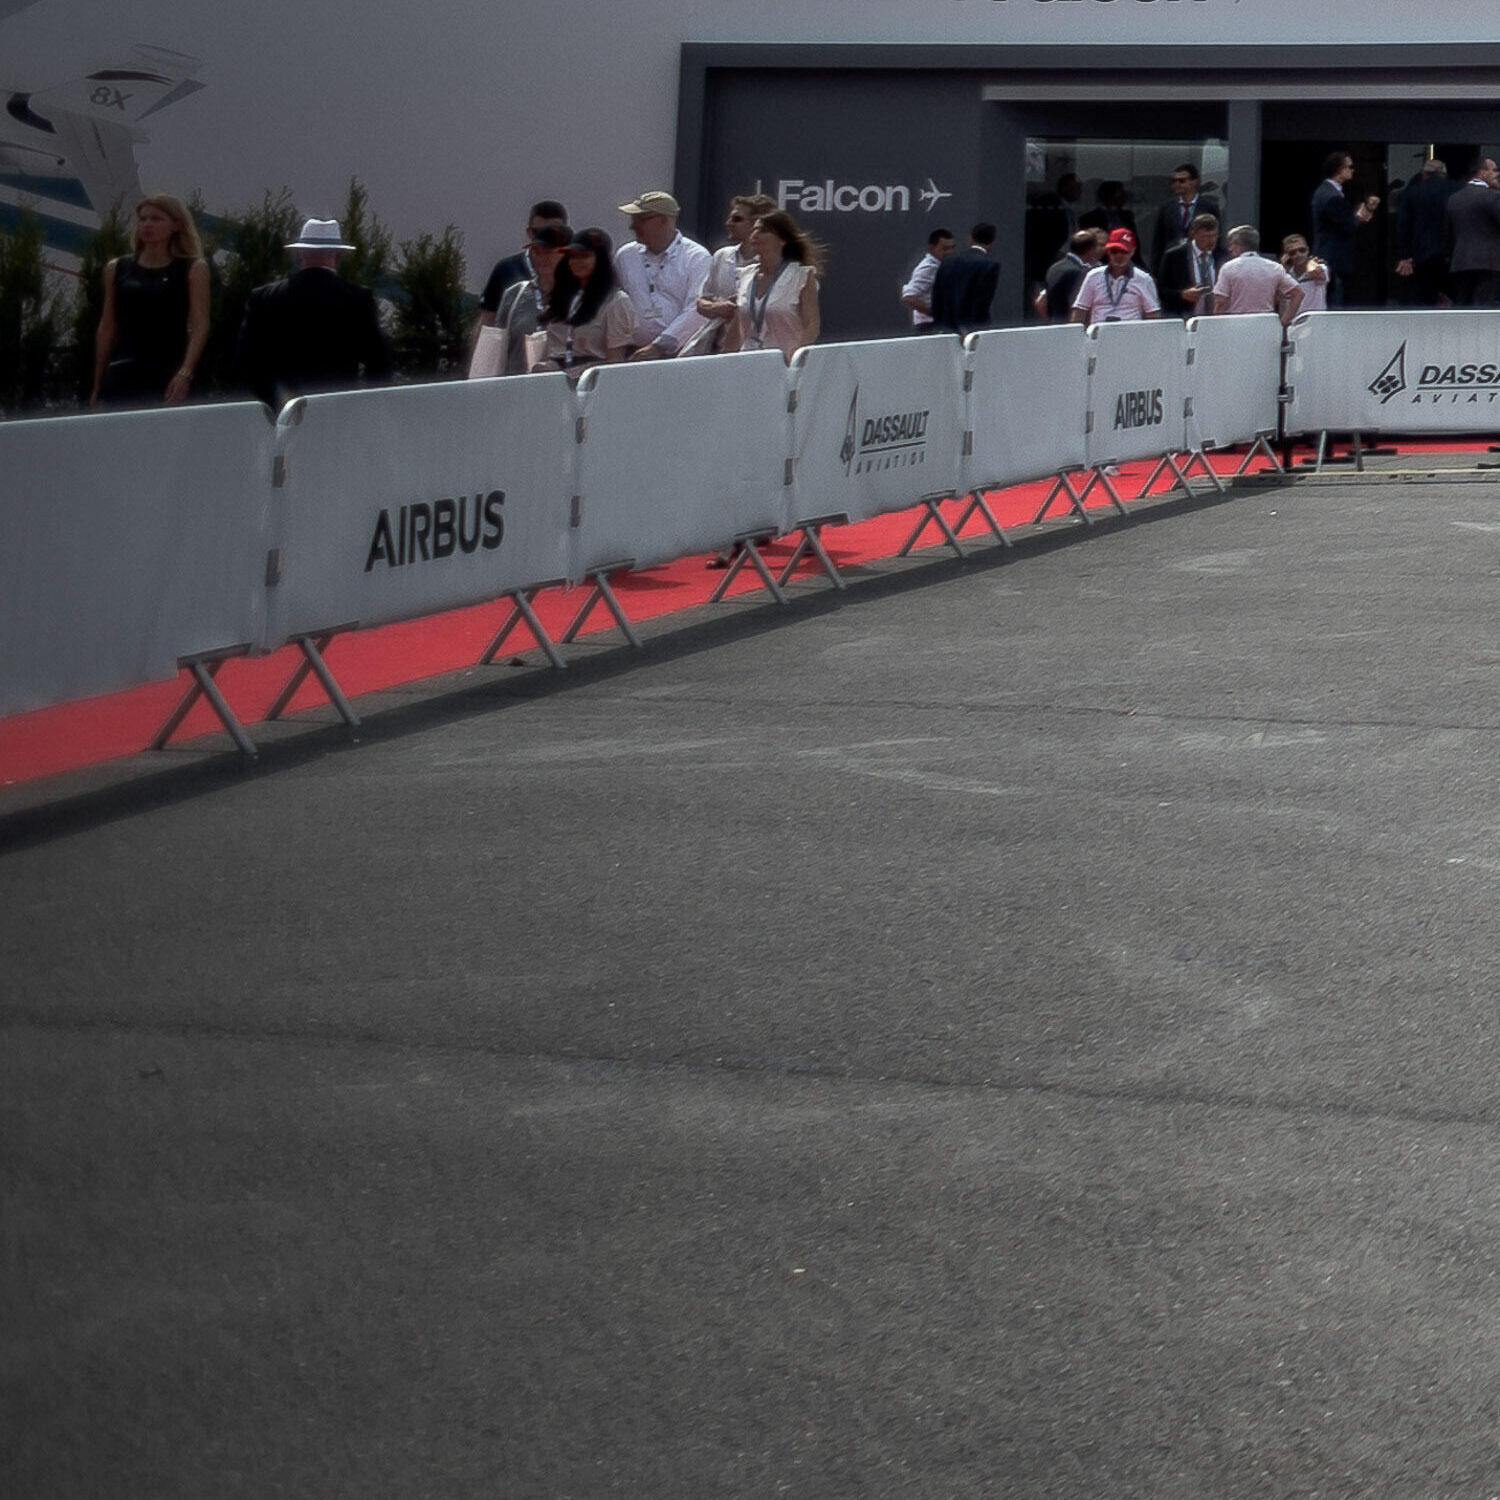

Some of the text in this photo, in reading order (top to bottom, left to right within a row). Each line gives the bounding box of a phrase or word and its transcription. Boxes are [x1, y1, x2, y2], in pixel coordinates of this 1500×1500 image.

[90, 86, 134, 110] 8X
[777, 179, 911, 212] Falcon
[1113, 388, 1163, 430] AIRBUS
[861, 410, 930, 447] DASSAULT
[364, 490, 506, 573] AIRBUS
